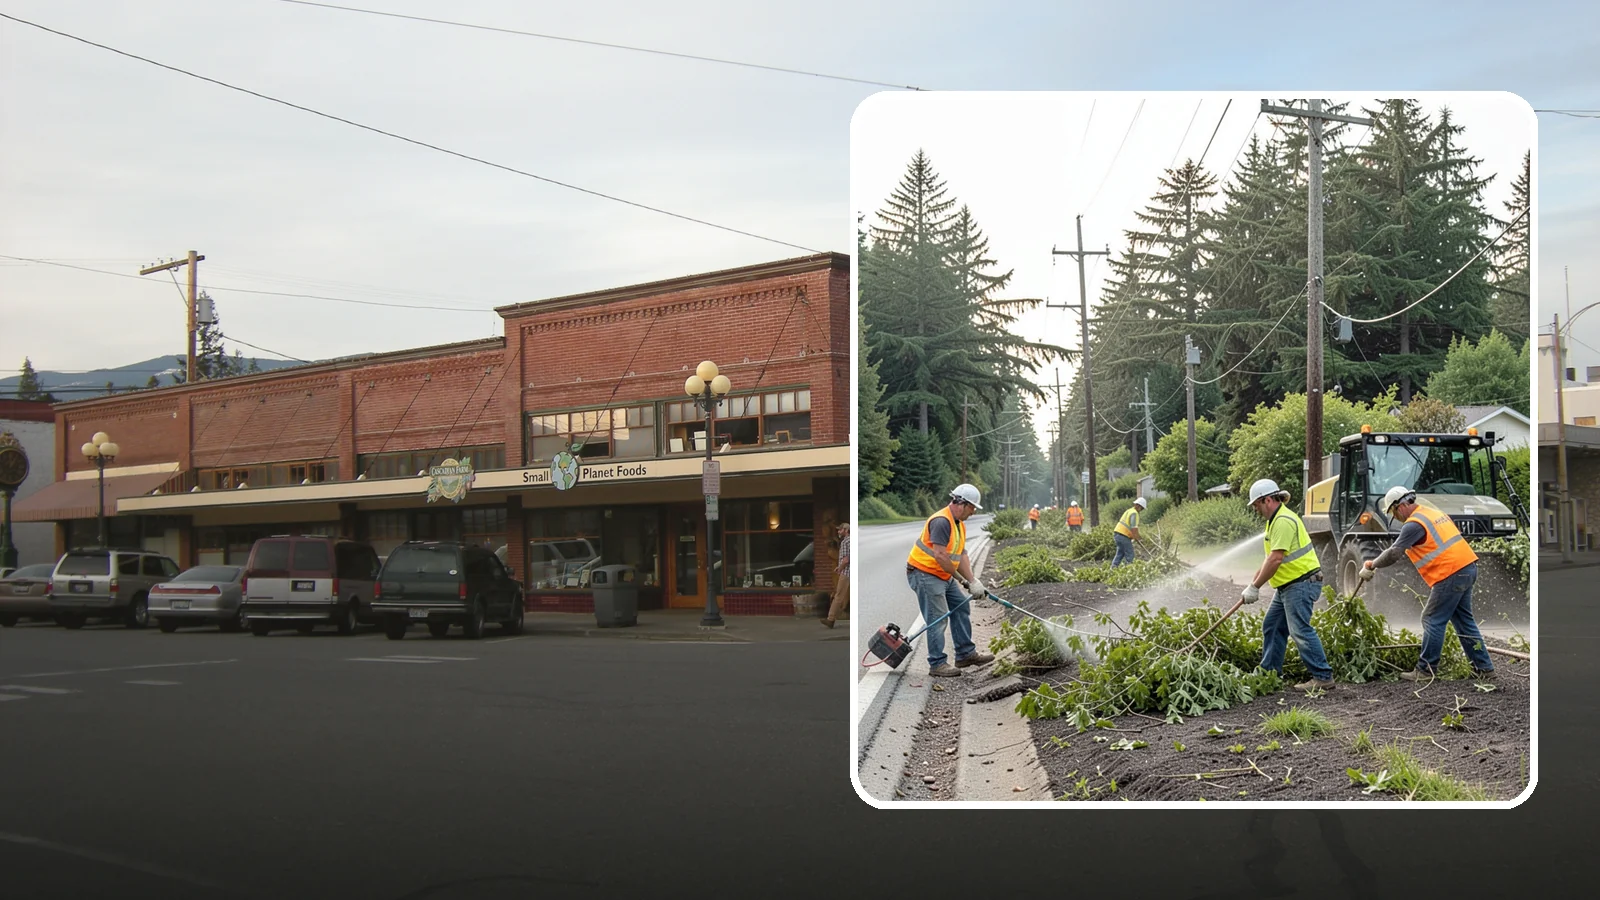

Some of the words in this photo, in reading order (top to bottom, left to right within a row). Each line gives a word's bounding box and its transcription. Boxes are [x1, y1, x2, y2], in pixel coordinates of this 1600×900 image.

[523, 471, 549, 483] Small
[583, 467, 614, 479] Planet
[617, 464, 647, 477] Foods
